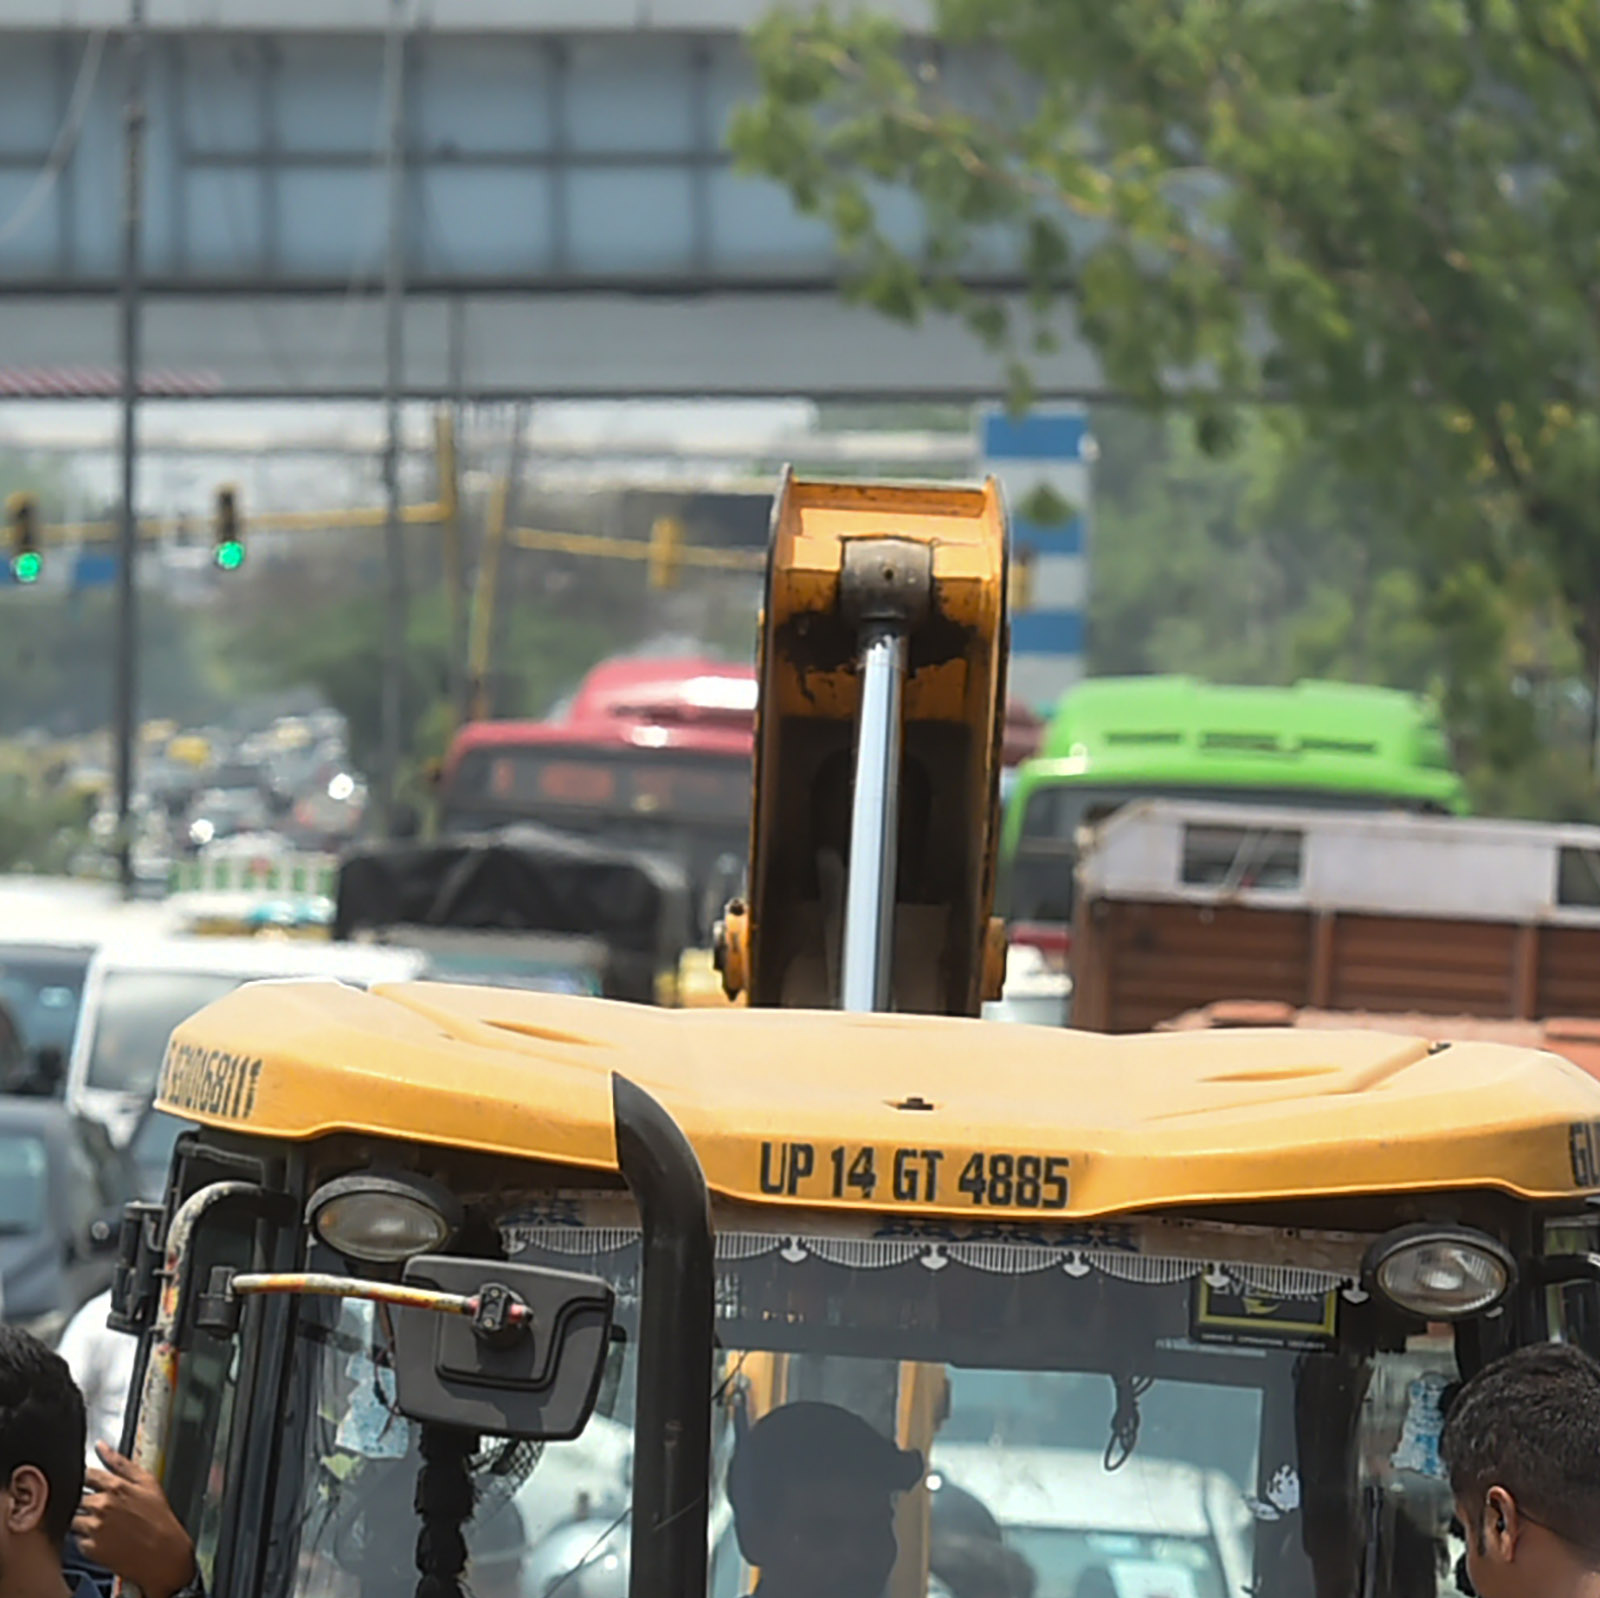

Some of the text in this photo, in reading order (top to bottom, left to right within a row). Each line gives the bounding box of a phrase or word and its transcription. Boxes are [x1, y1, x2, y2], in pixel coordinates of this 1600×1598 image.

[760, 1141, 1070, 1210] UP 14 GT 4885
